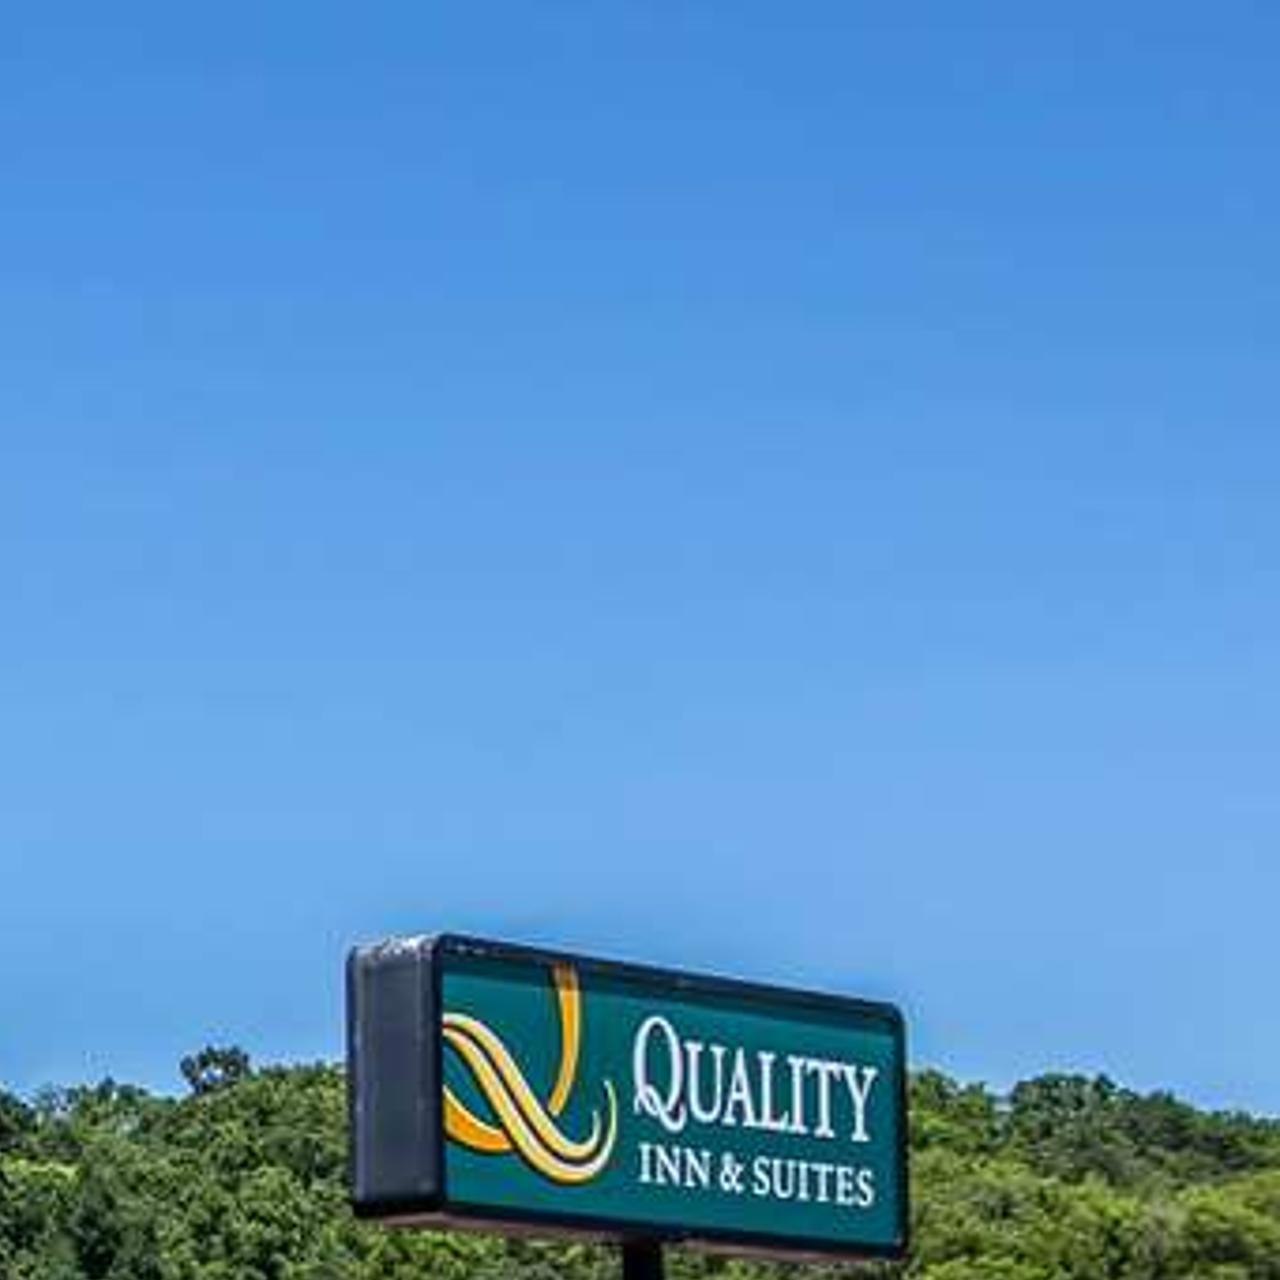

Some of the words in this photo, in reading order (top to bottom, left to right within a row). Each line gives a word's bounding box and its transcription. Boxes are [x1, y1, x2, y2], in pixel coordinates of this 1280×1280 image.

[633, 1016, 879, 1142] QUALITY
[639, 1142, 711, 1188] INN
[720, 1152, 744, 1193] &
[753, 1156, 874, 1207] SUITES
